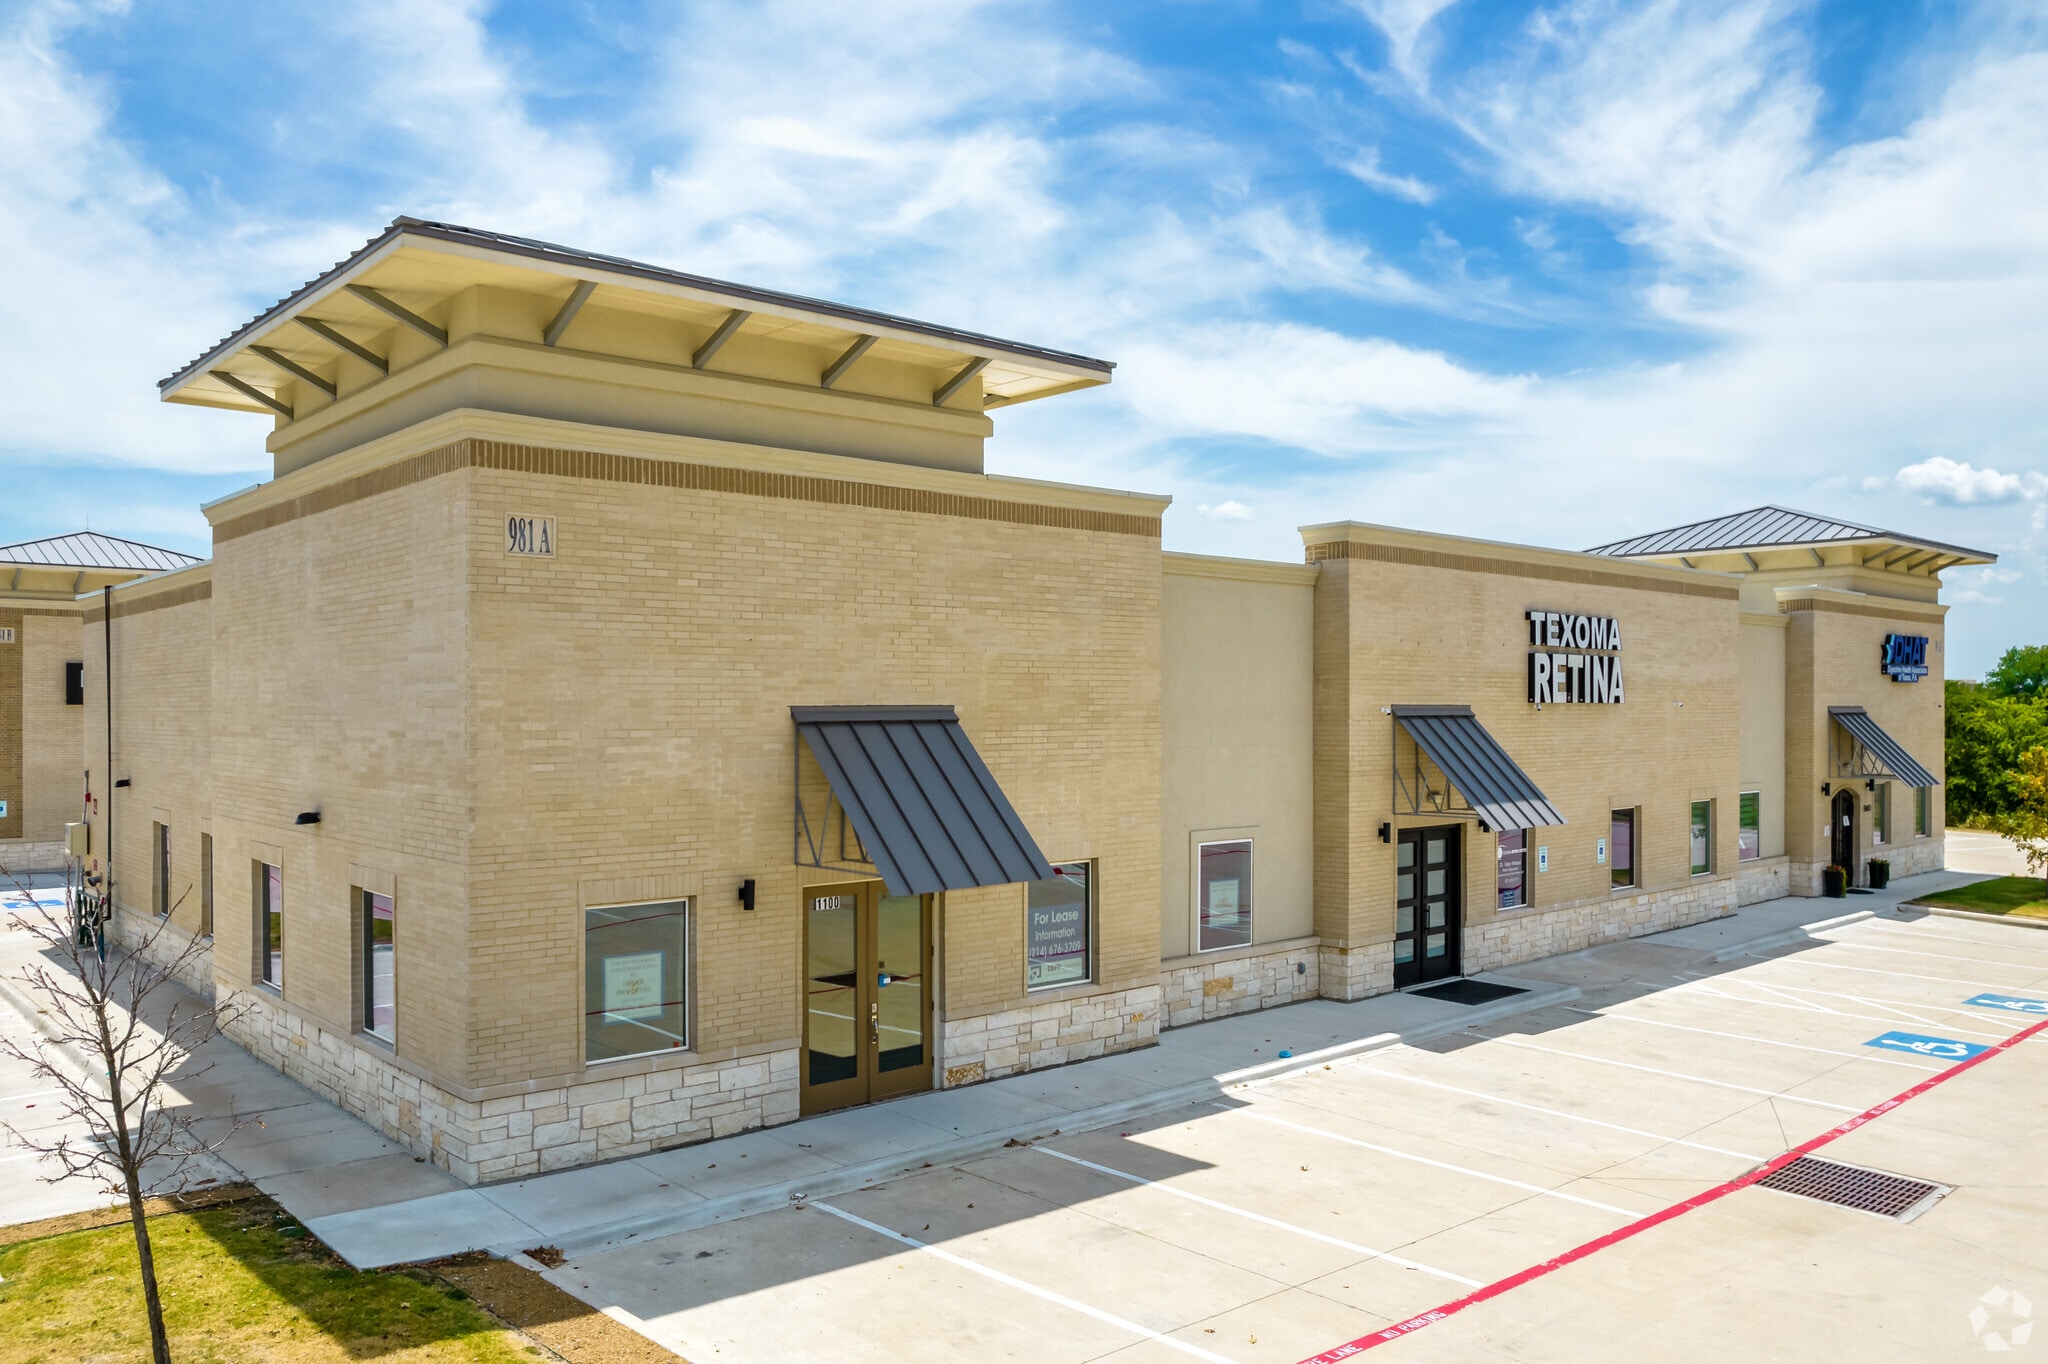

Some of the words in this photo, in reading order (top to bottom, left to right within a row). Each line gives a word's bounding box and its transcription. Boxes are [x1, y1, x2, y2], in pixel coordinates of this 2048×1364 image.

[508, 517, 534, 553] 981
[539, 519, 551, 554] A
[1529, 611, 1622, 651] TEXOMA
[1895, 635, 1928, 665] DHAT
[1532, 652, 1625, 704] RETINA
[817, 897, 839, 909] 1100
[1034, 912, 1049, 925] For
[1051, 910, 1079, 923] Lease
[1035, 927, 1076, 942] Information
[1029, 946, 1047, 958] (214)
[1324, 1344, 1363, 1360] LANE
[1378, 1329, 1400, 1340] NO
[1398, 1310, 1447, 1332] PARKING
